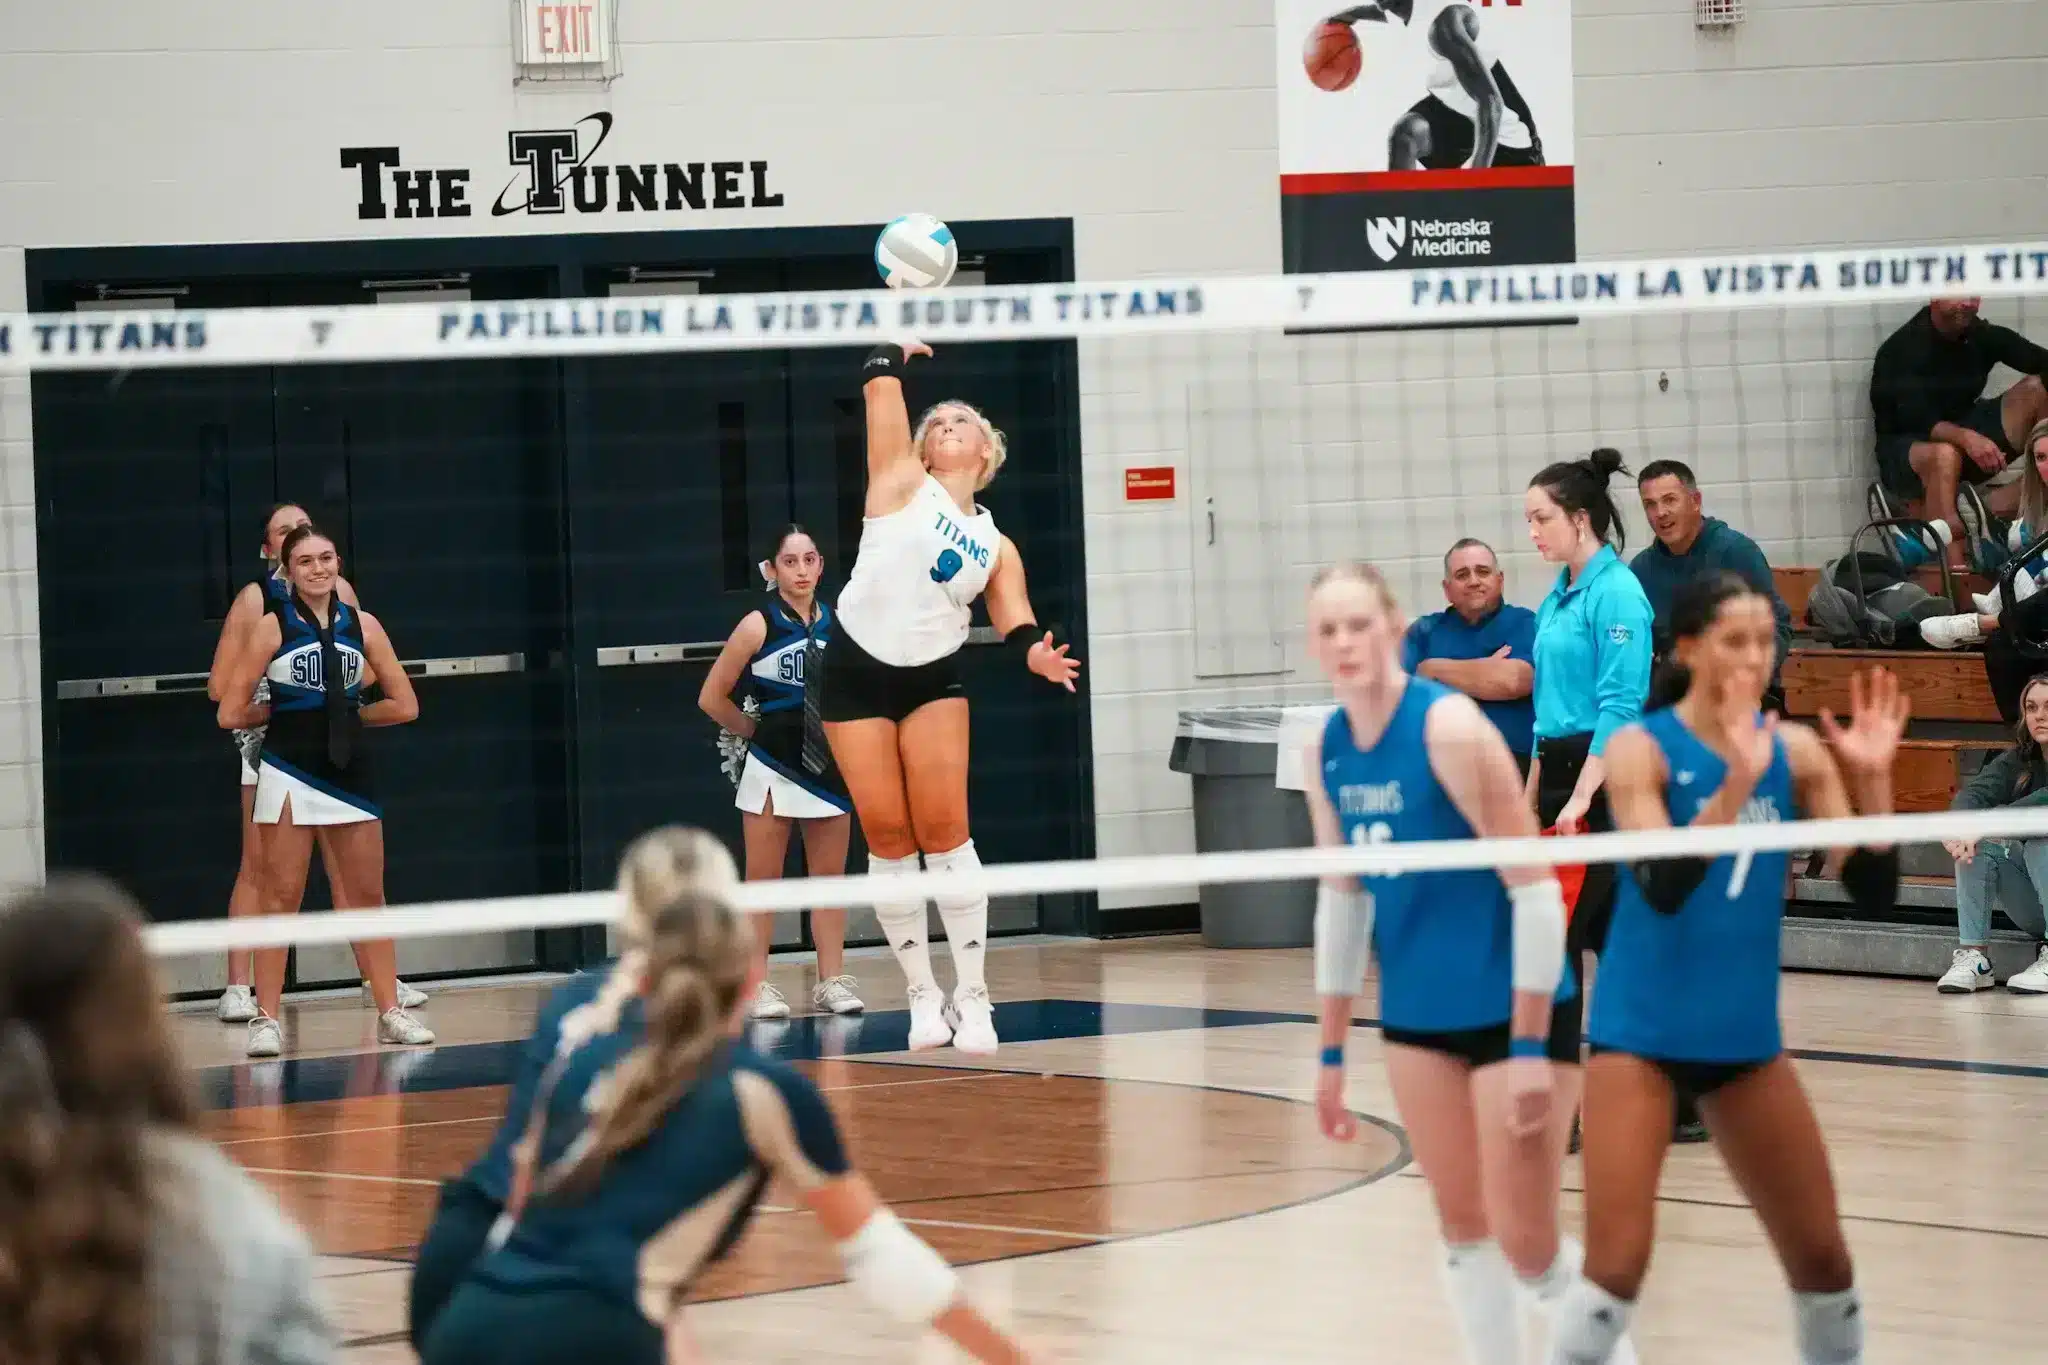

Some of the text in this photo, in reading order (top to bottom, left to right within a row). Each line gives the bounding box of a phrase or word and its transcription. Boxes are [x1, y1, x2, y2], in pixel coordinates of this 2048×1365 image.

[538, 4, 592, 54] EXIT
[1411, 218, 1491, 238] Nebraska
[1411, 237, 1491, 257] Medicine
[1410, 272, 1618, 306] PAPILLION
[1636, 269, 1683, 298] LA
[1703, 263, 1820, 294] VISTA
[1837, 256, 1966, 288] SOUTH
[437, 285, 1205, 341] PAPILLION LA VISTA SOUTH TITANS
[32, 319, 208, 355] TITANS
[934, 511, 990, 569] TITANS
[929, 548, 963, 583] 9
